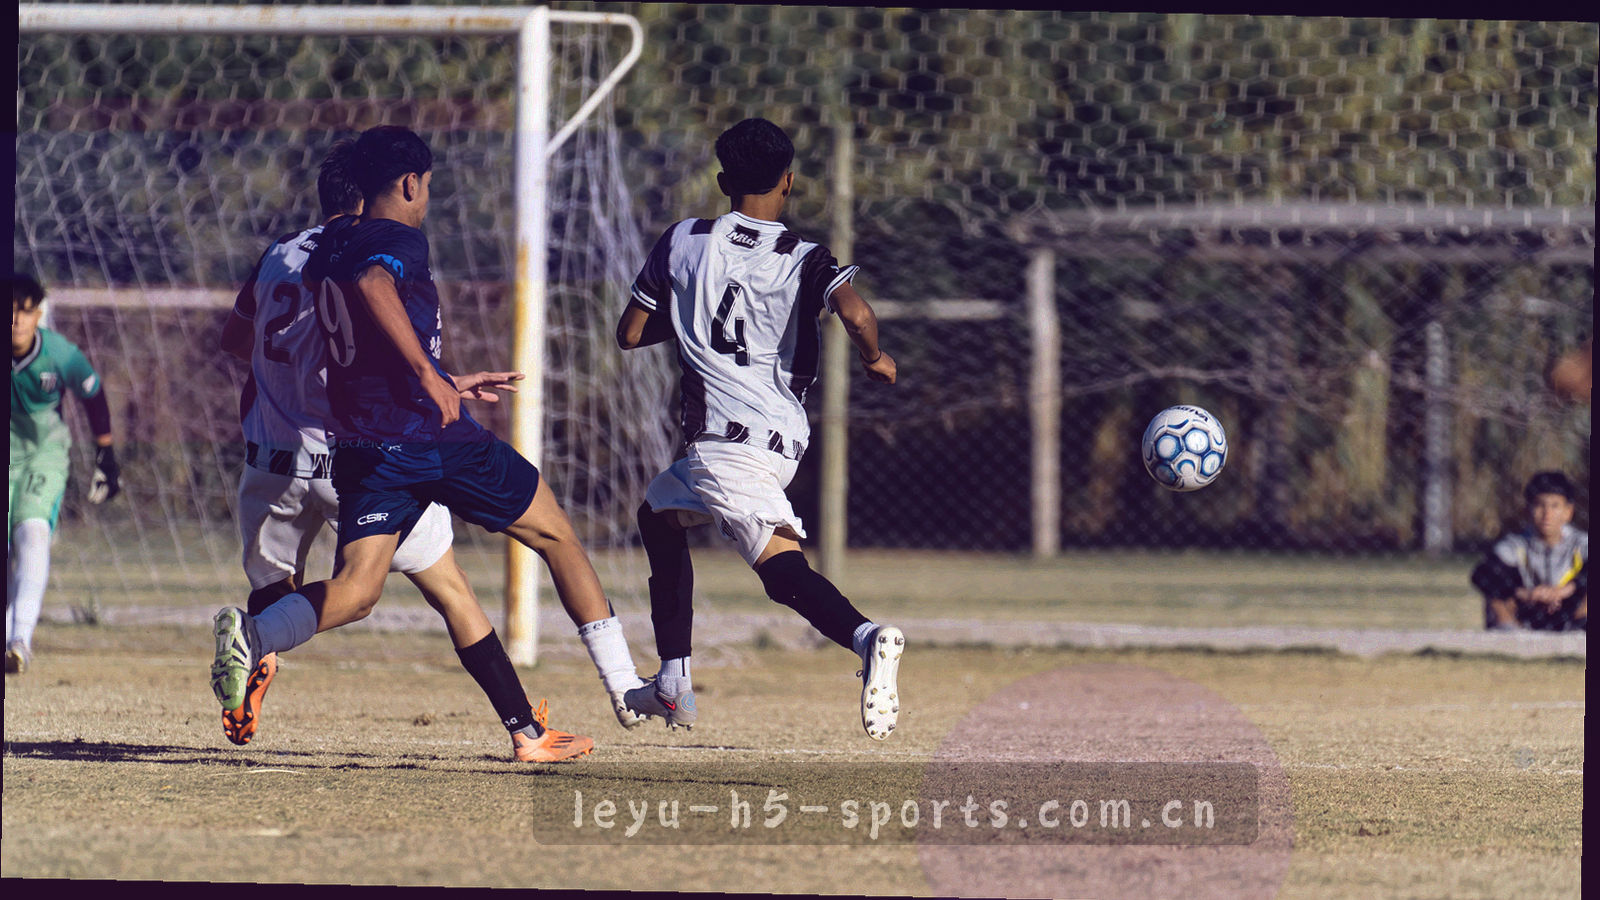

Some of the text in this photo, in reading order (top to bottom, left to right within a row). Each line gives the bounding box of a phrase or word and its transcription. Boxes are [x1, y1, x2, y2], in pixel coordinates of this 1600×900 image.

[263, 281, 301, 364] 2
[319, 276, 356, 368] 9
[711, 283, 751, 367] 4
[25, 472, 47, 496] 12
[357, 512, 389, 526] CSIR
